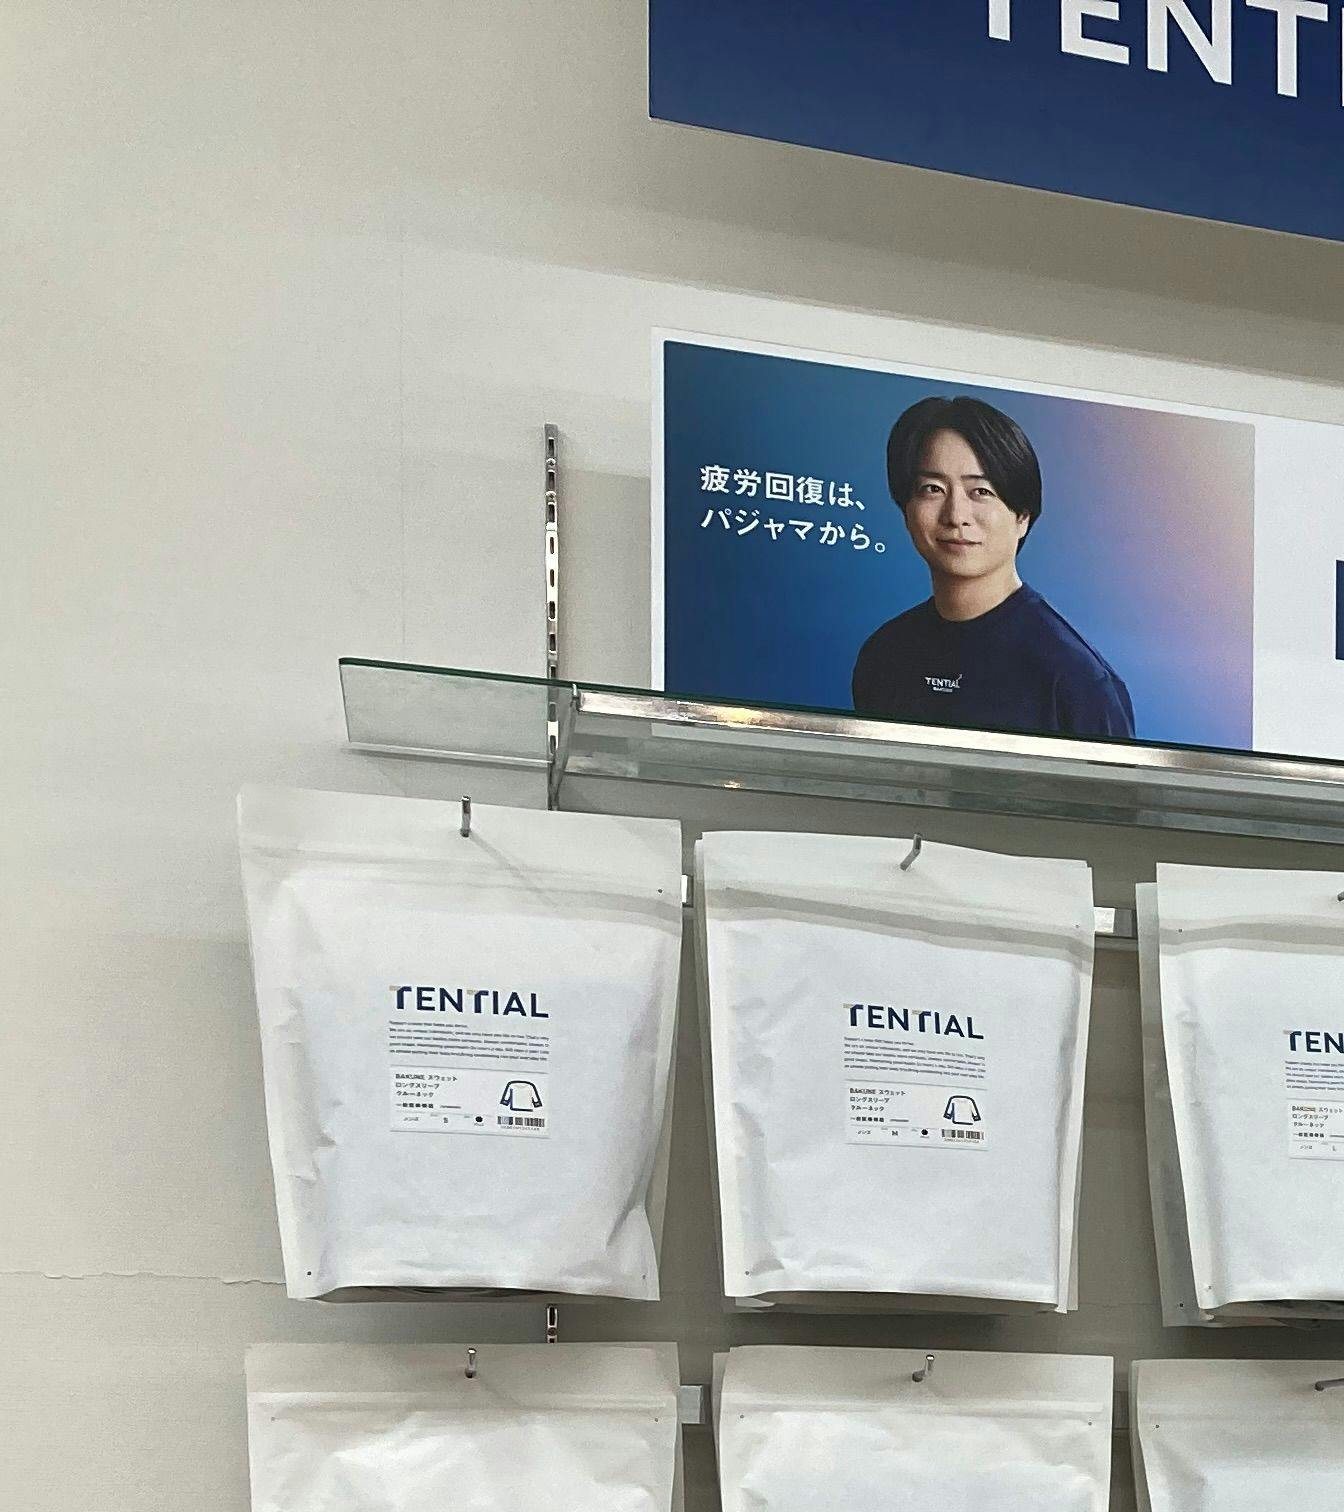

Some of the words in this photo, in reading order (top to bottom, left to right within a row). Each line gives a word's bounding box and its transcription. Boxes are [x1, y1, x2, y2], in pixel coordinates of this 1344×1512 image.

[700, 464, 866, 511] 疲労回復は、
[700, 508, 886, 553] パジャマから。
[389, 985, 549, 1019] TENTIAL
[843, 1005, 983, 1039] TENTIAL
